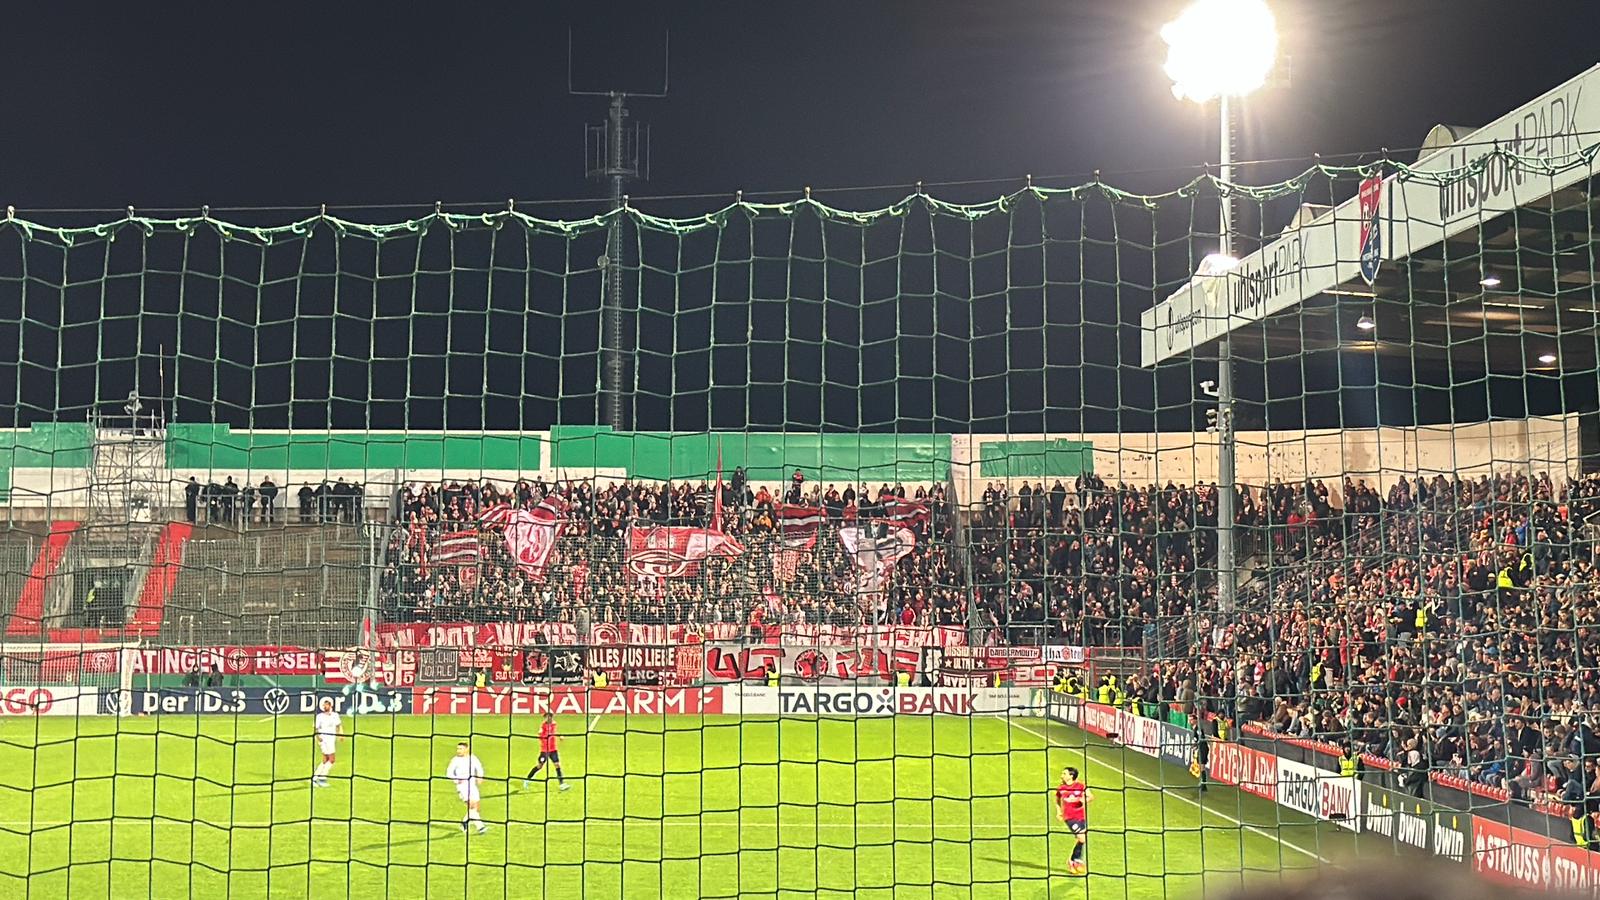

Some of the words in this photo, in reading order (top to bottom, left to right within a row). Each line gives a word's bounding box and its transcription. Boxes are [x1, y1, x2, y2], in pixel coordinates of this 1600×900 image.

[589, 648, 619, 668] ALLES
[622, 648, 642, 667] AUS
[645, 648, 675, 667] LIEBE
[0, 688, 53, 714] GO
[143, 692, 189, 712] Der
[195, 690, 246, 713] ID.3
[450, 687, 686, 714] FLYERALARM
[1366, 792, 1393, 837] bwin
[1398, 801, 1427, 849] bwin
[1434, 812, 1464, 863] bwin
[1486, 834, 1540, 885] STRAUSS
